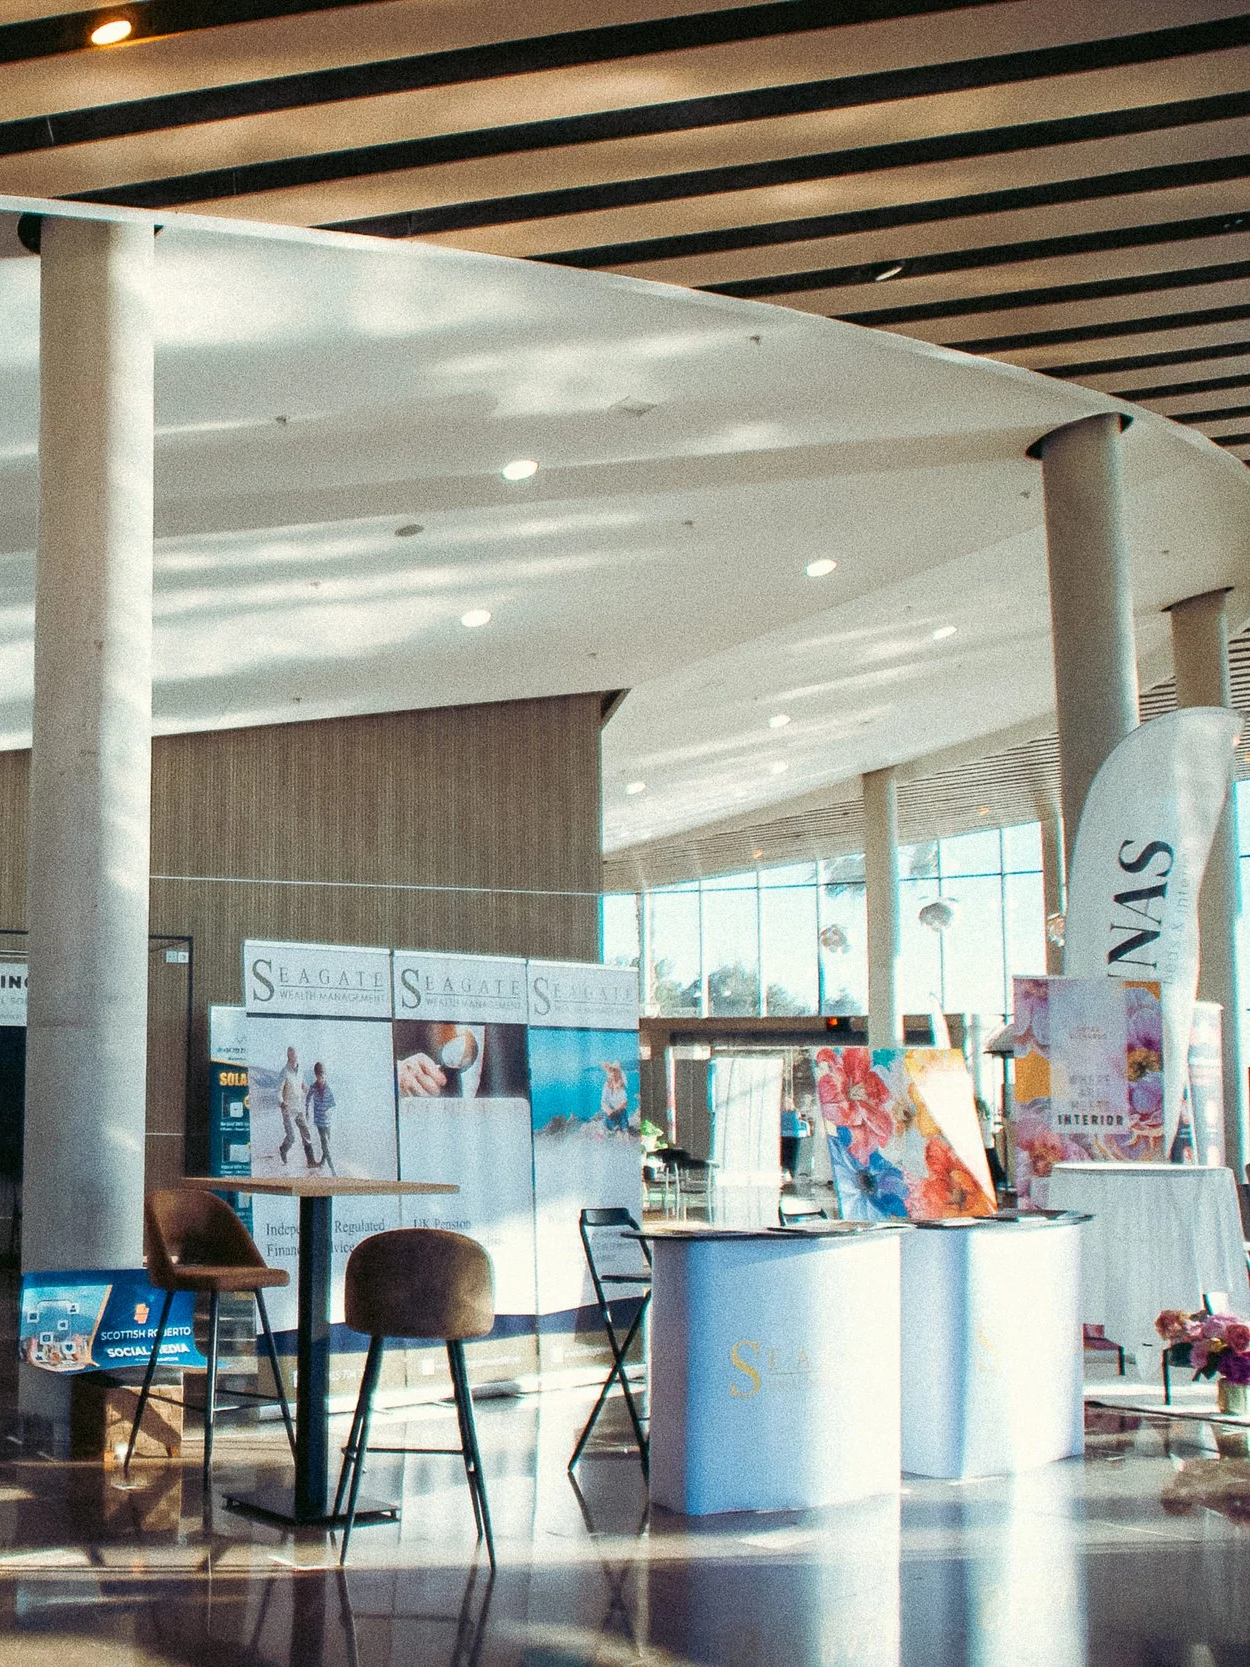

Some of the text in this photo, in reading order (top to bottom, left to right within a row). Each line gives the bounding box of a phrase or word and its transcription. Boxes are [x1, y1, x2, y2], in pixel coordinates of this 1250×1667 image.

[252, 958, 384, 1002] SEAGATE
[401, 968, 521, 1009] SEAGATE
[1057, 1114, 1124, 1126] INTERIOR
[334, 1220, 385, 1235] Regulated
[101, 1329, 146, 1341] SCOTTISH
[107, 1345, 152, 1358] SOCIAL
